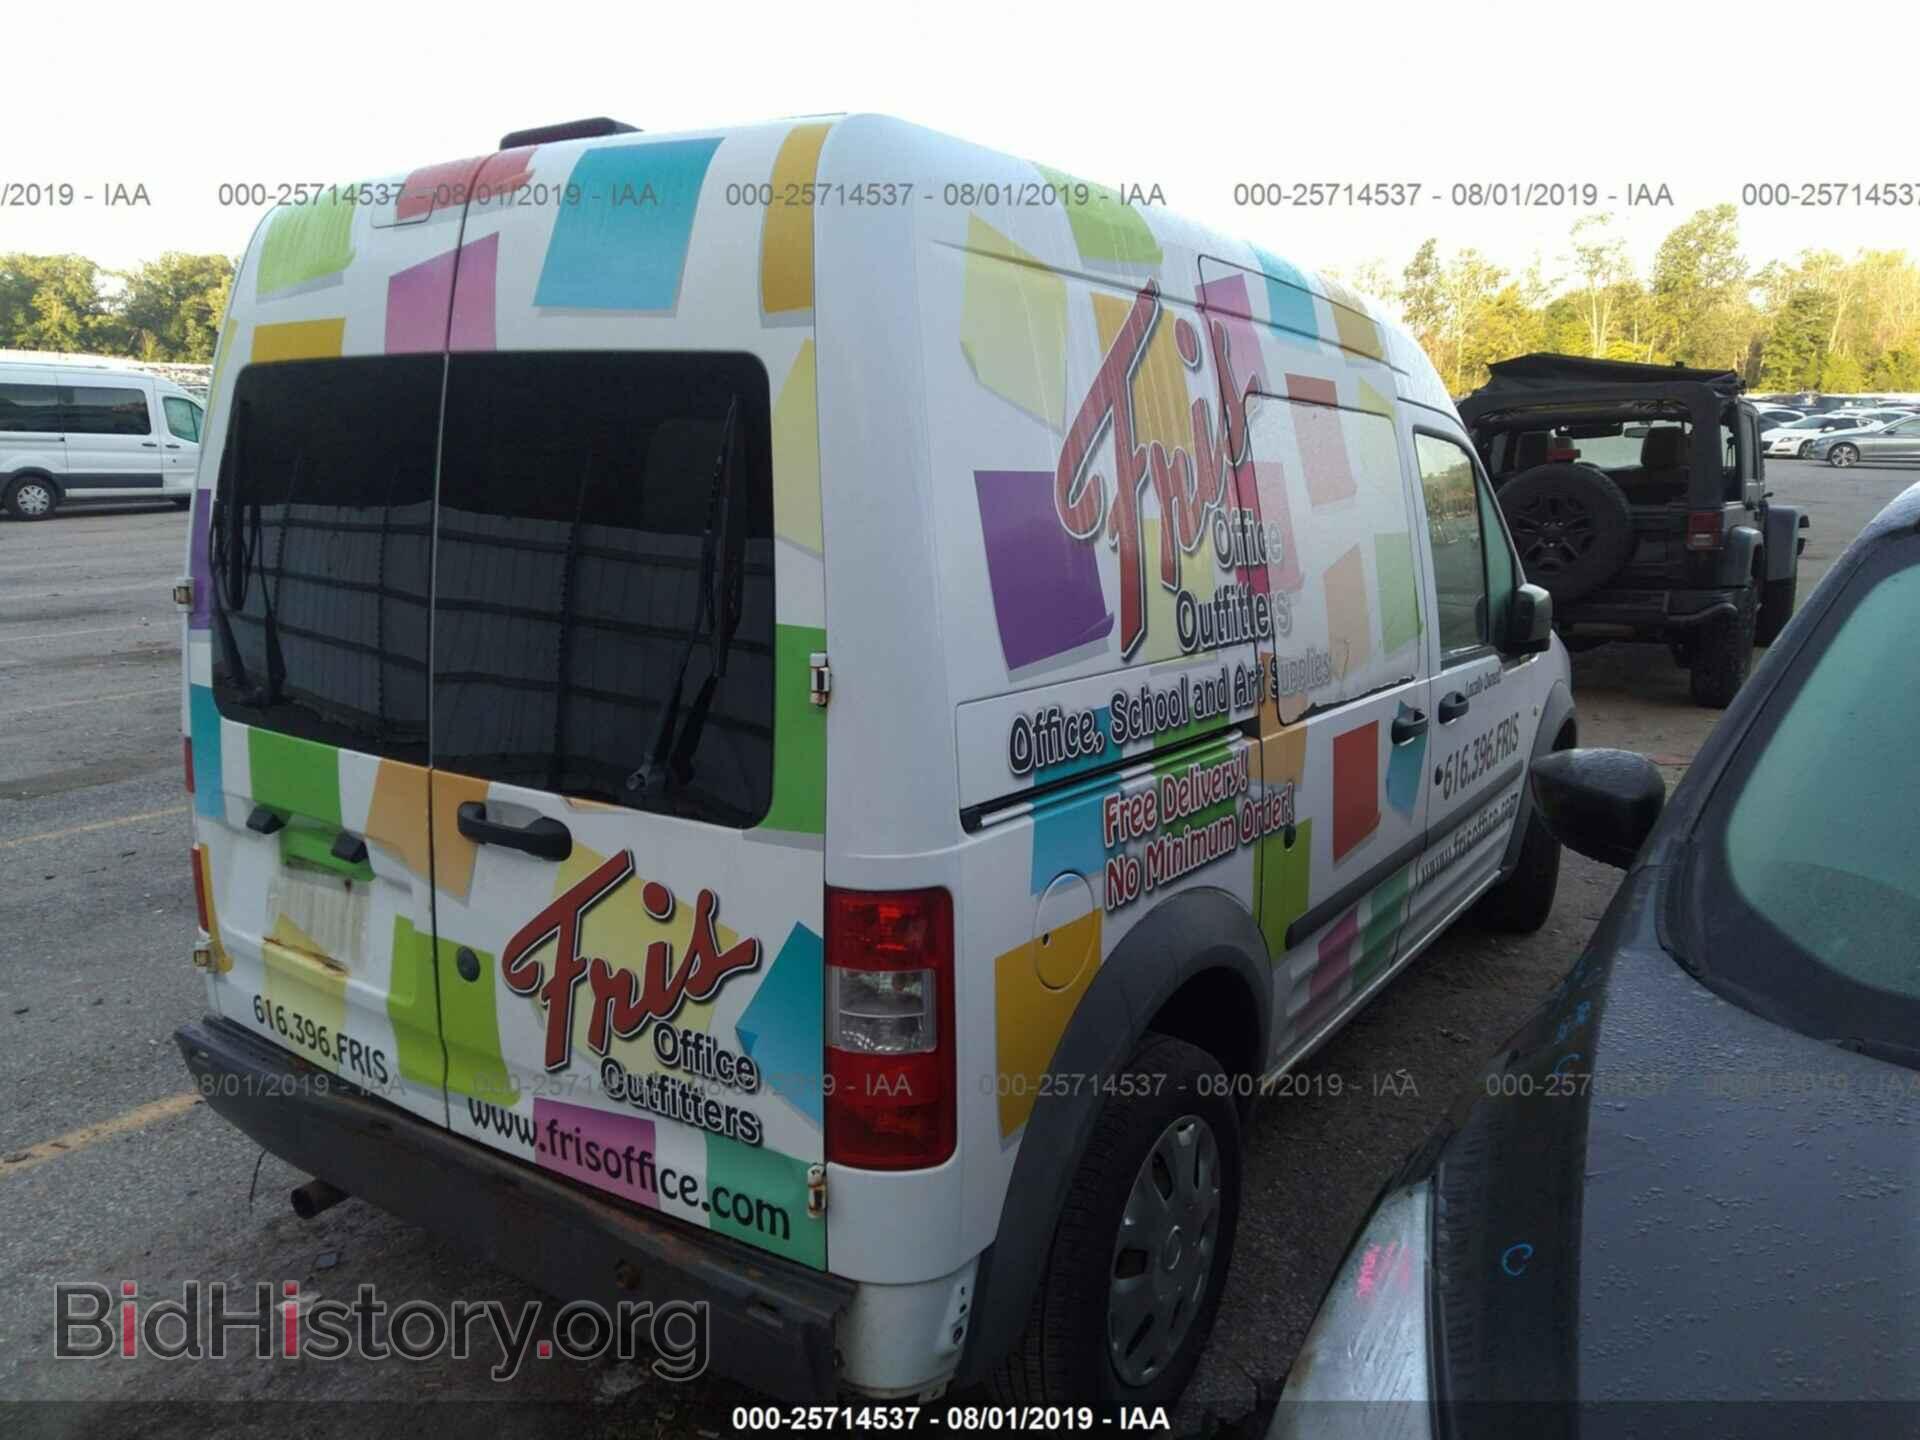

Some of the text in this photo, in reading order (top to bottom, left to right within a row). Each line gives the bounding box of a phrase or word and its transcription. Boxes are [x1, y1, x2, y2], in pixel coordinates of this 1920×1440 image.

[1055, 278, 1263, 658] Fris
[1211, 508, 1283, 569] Office
[1176, 581, 1293, 653] Outfitters
[1009, 706, 1104, 775] Office,
[1110, 675, 1188, 743] School
[1193, 664, 1230, 718] and
[1233, 660, 1264, 707] Art
[1443, 712, 1520, 801] 616.396.FRIS
[1104, 746, 1249, 848] Free Delivery!
[1105, 782, 1295, 910] No Minimum Order!
[502, 848, 762, 1074] Fris
[253, 994, 389, 1085] 616.396.FRIS
[653, 1020, 761, 1093] Office
[600, 1055, 764, 1146] Outfitters
[467, 1096, 790, 1241] www.frisoffice.com
